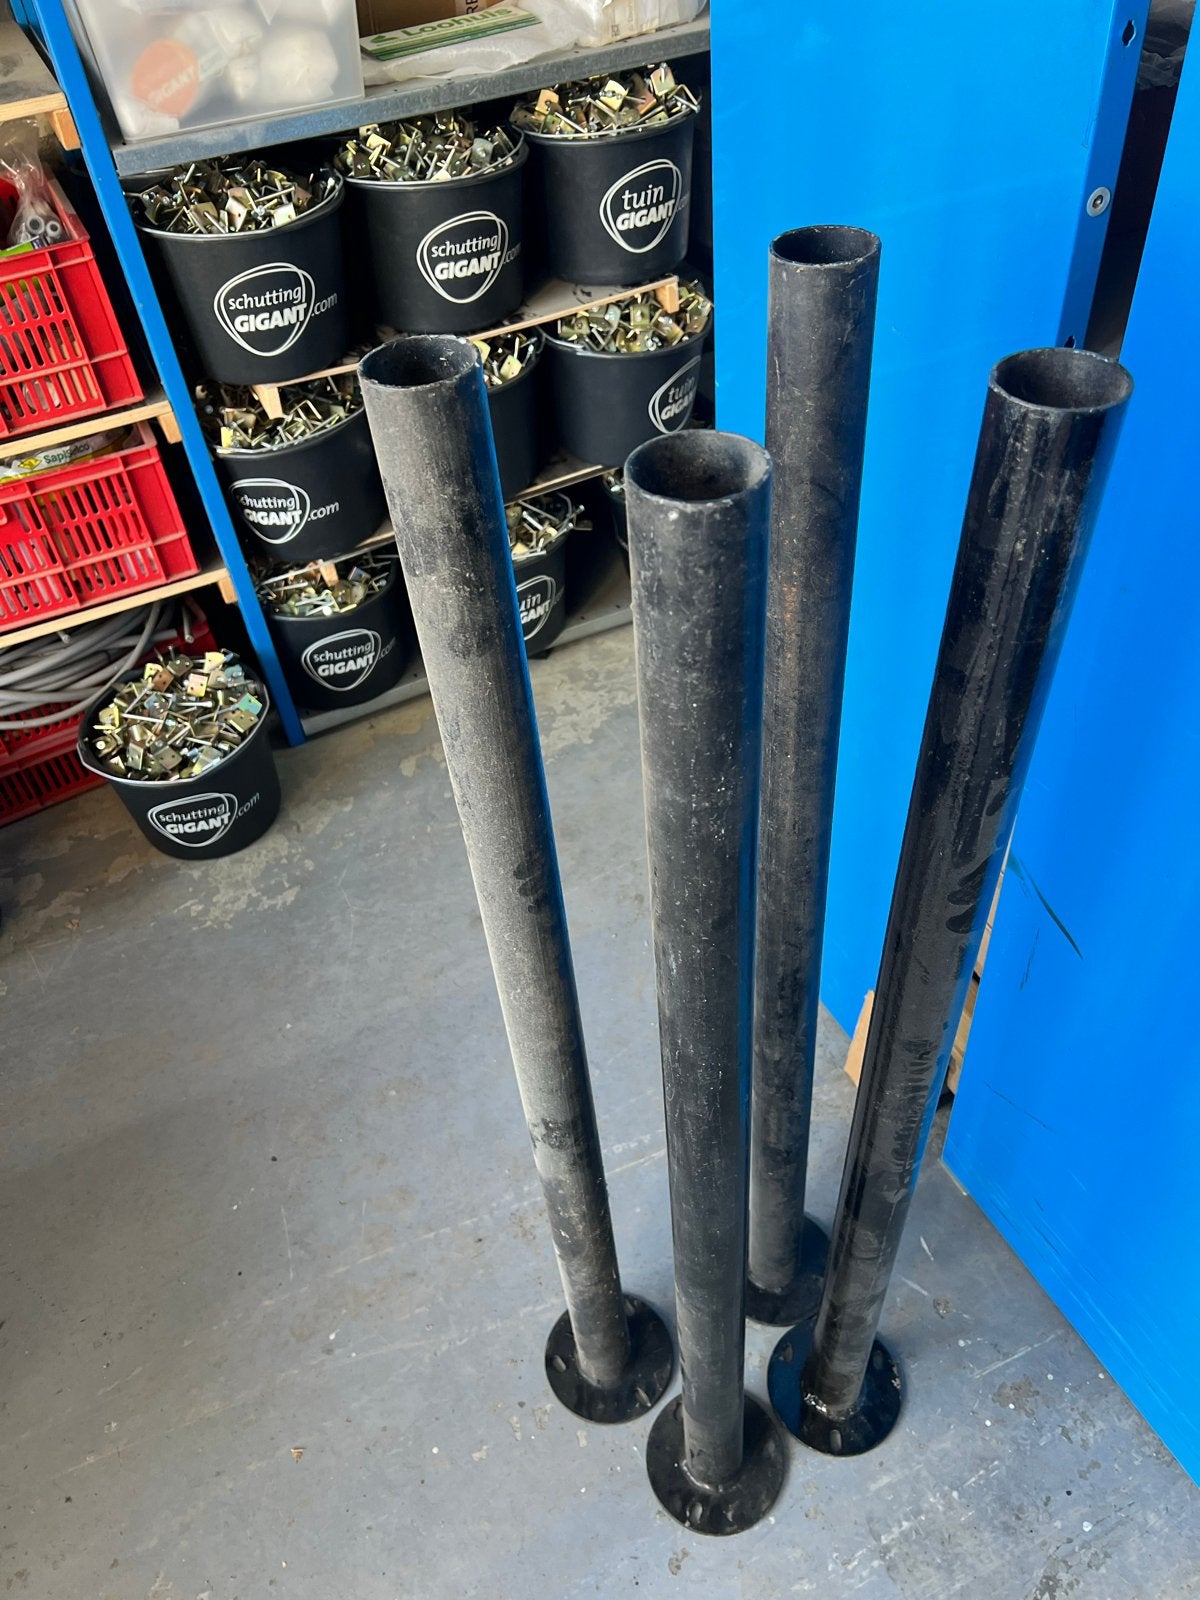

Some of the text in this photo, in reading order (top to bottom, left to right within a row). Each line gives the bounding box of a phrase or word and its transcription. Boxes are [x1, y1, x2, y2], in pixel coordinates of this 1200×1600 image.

[621, 184, 664, 210] tuin
[616, 199, 675, 231] GIGANT
[431, 235, 498, 258] schutting
[434, 251, 501, 280] GIGANT
[228, 286, 301, 310] schutting
[234, 302, 307, 333] GIGANT
[239, 494, 295, 511] chutting
[307, 501, 340, 522] .com
[313, 641, 371, 662] schutting
[318, 652, 375, 677] GIGANT
[159, 803, 225, 822] schutting
[165, 812, 230, 834] GIGANT
